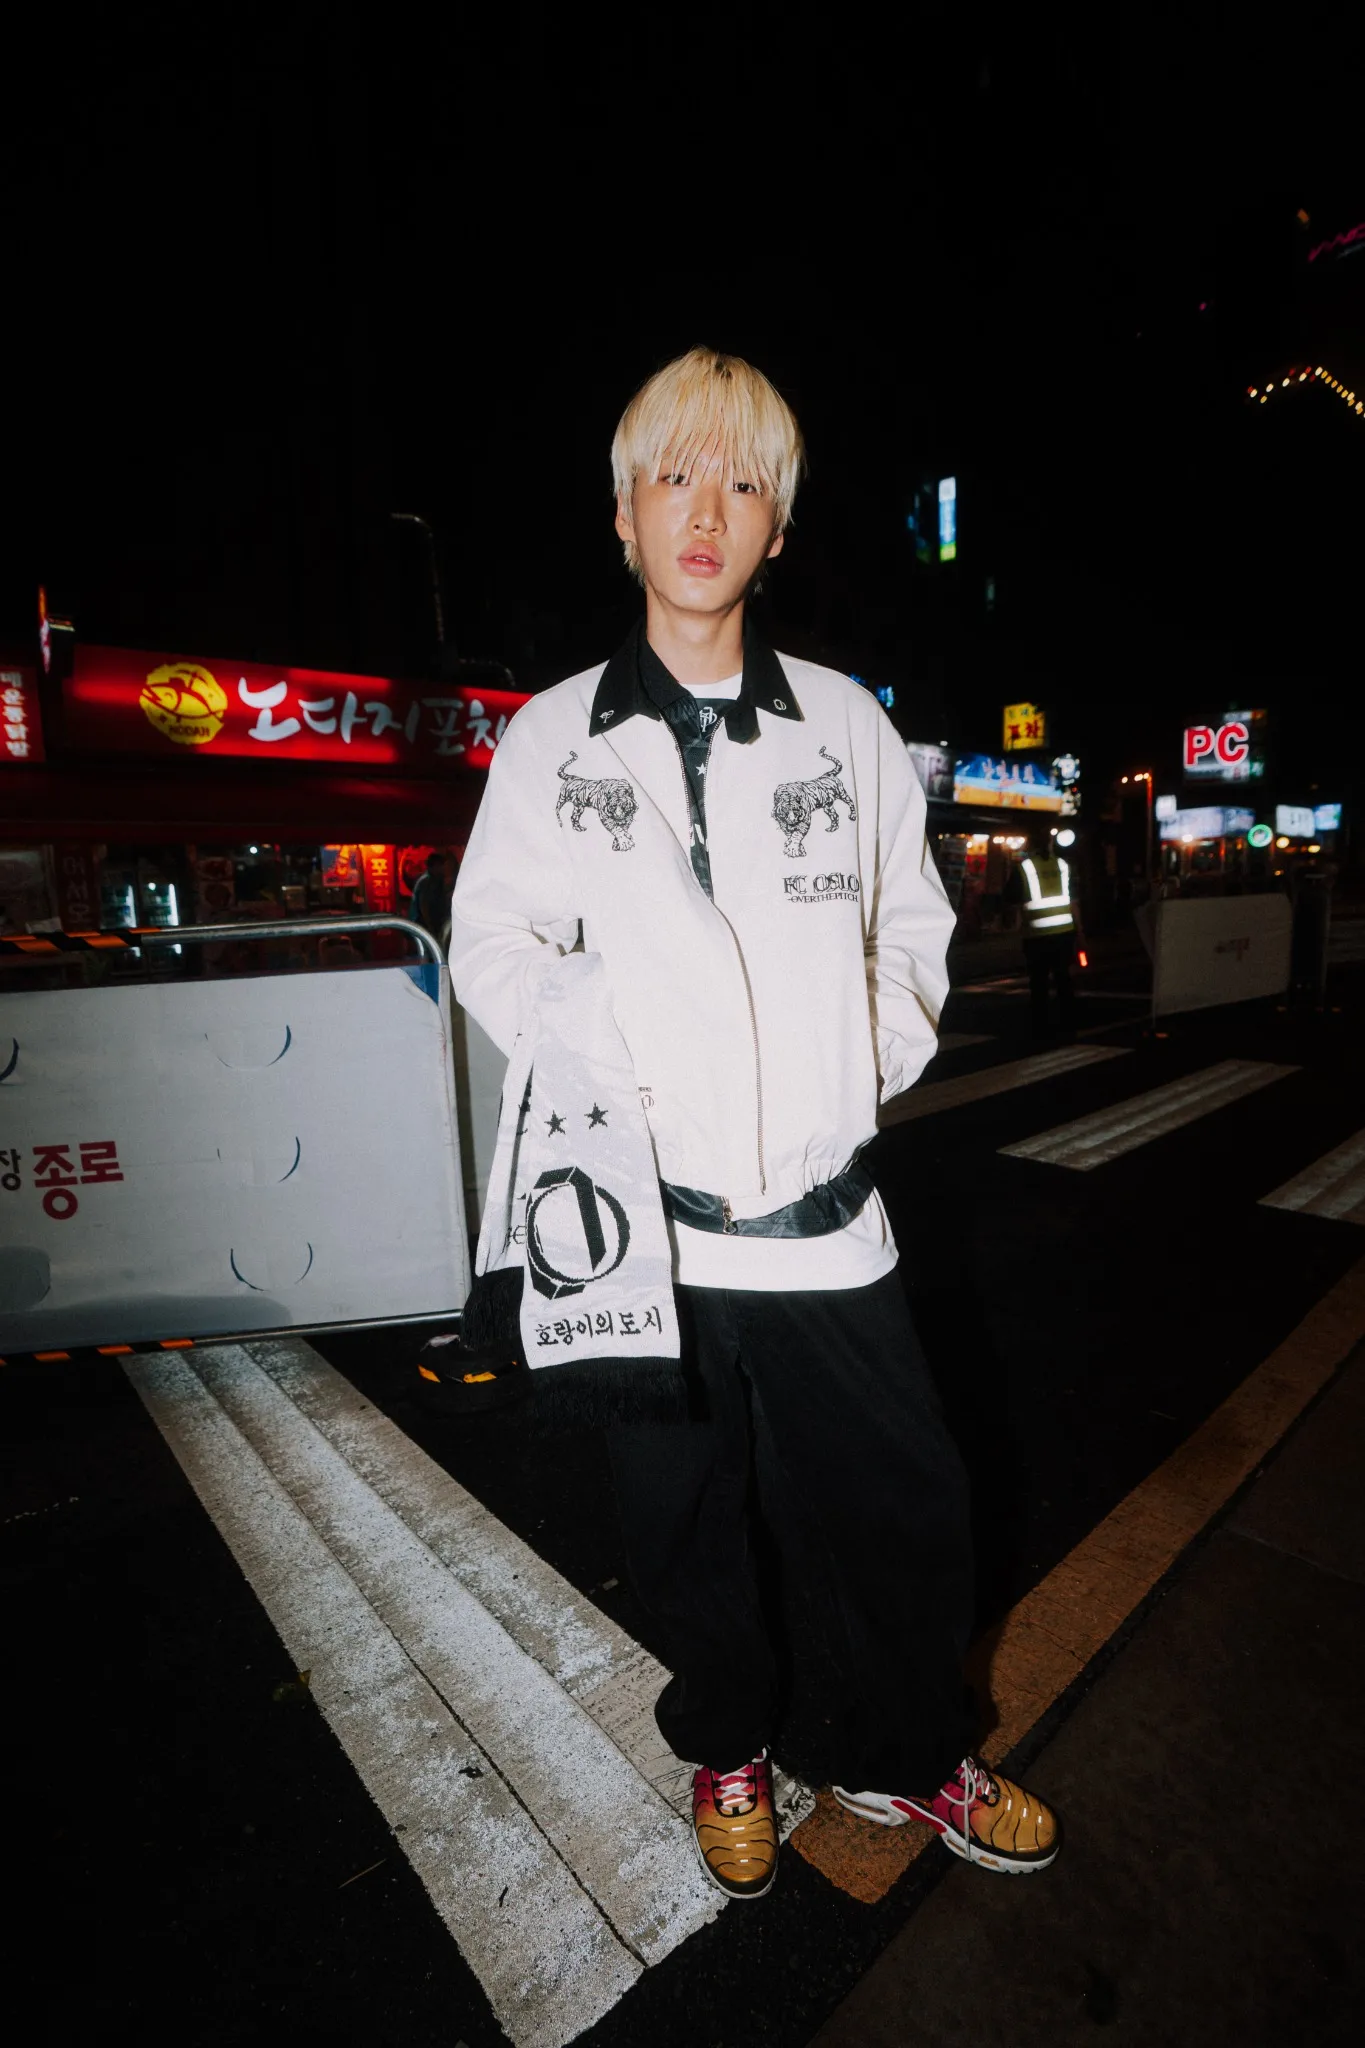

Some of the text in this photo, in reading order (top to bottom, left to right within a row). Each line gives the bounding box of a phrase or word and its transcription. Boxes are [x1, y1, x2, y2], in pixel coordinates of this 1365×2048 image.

[1183, 721, 1250, 769] PC
[782, 872, 860, 894] FC OSLO
[33, 1140, 124, 1220] 종로
[536, 1306, 663, 1346] 호랑이의 도시
